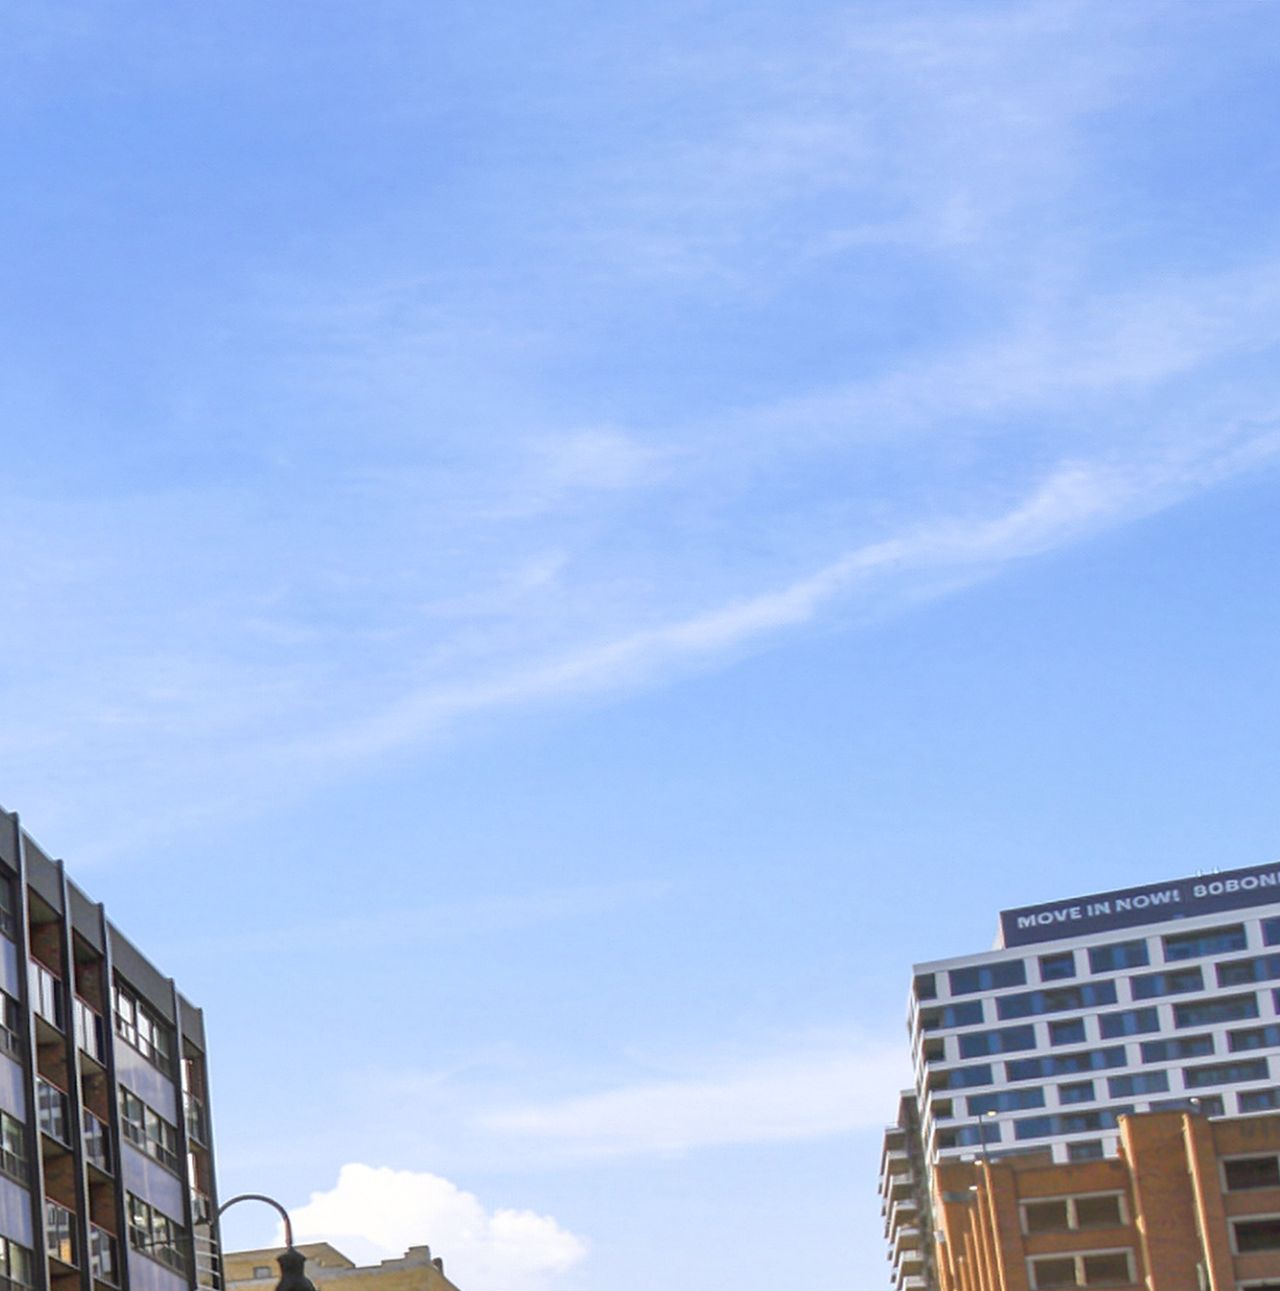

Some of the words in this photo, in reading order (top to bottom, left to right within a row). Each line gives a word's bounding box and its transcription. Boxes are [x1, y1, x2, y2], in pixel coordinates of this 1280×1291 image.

[1017, 906, 1083, 929] MOVE
[1086, 901, 1111, 917] IN
[1114, 889, 1181, 912] NOW!
